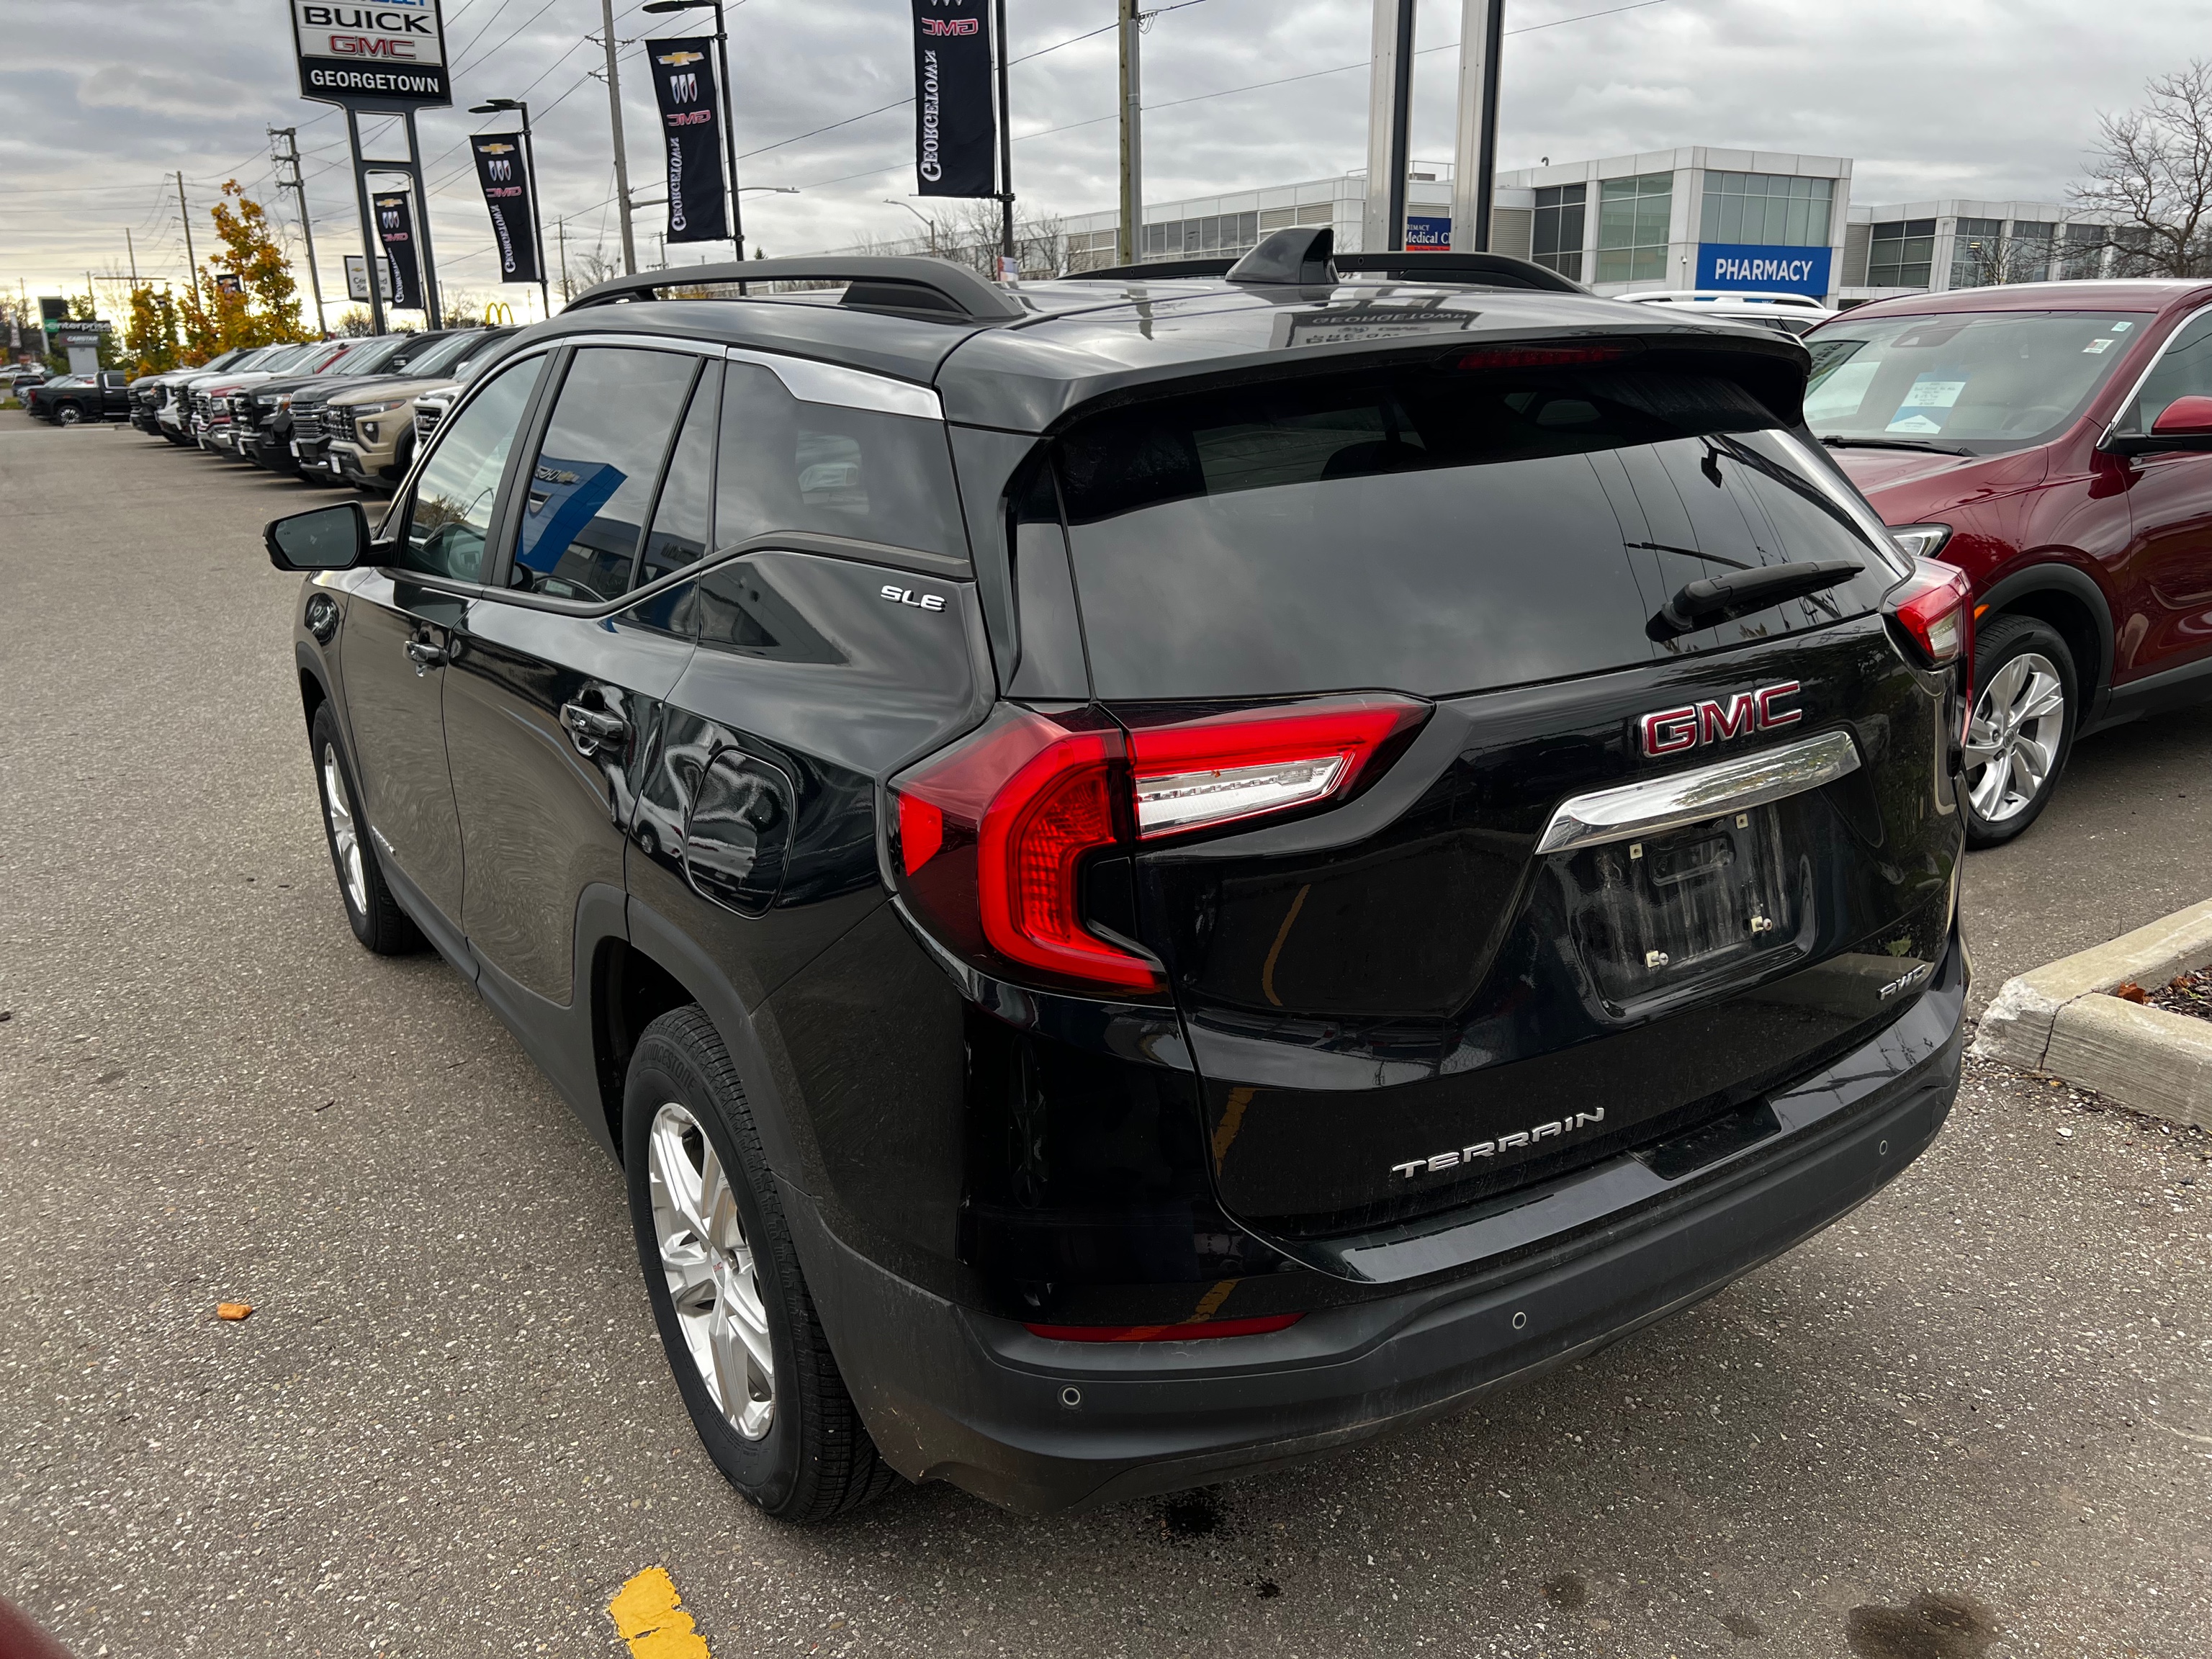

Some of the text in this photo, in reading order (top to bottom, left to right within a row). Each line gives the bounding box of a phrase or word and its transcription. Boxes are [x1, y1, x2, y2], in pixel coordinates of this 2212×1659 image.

[304, 6, 433, 35] BUICK
[329, 34, 415, 59] GMC
[310, 69, 440, 93] GEORGETOWN
[1714, 258, 1813, 282] PHARMACY
[880, 585, 947, 612] SLE
[1640, 680, 1802, 758] GMC
[1391, 1107, 1605, 1179] TERRAIN
